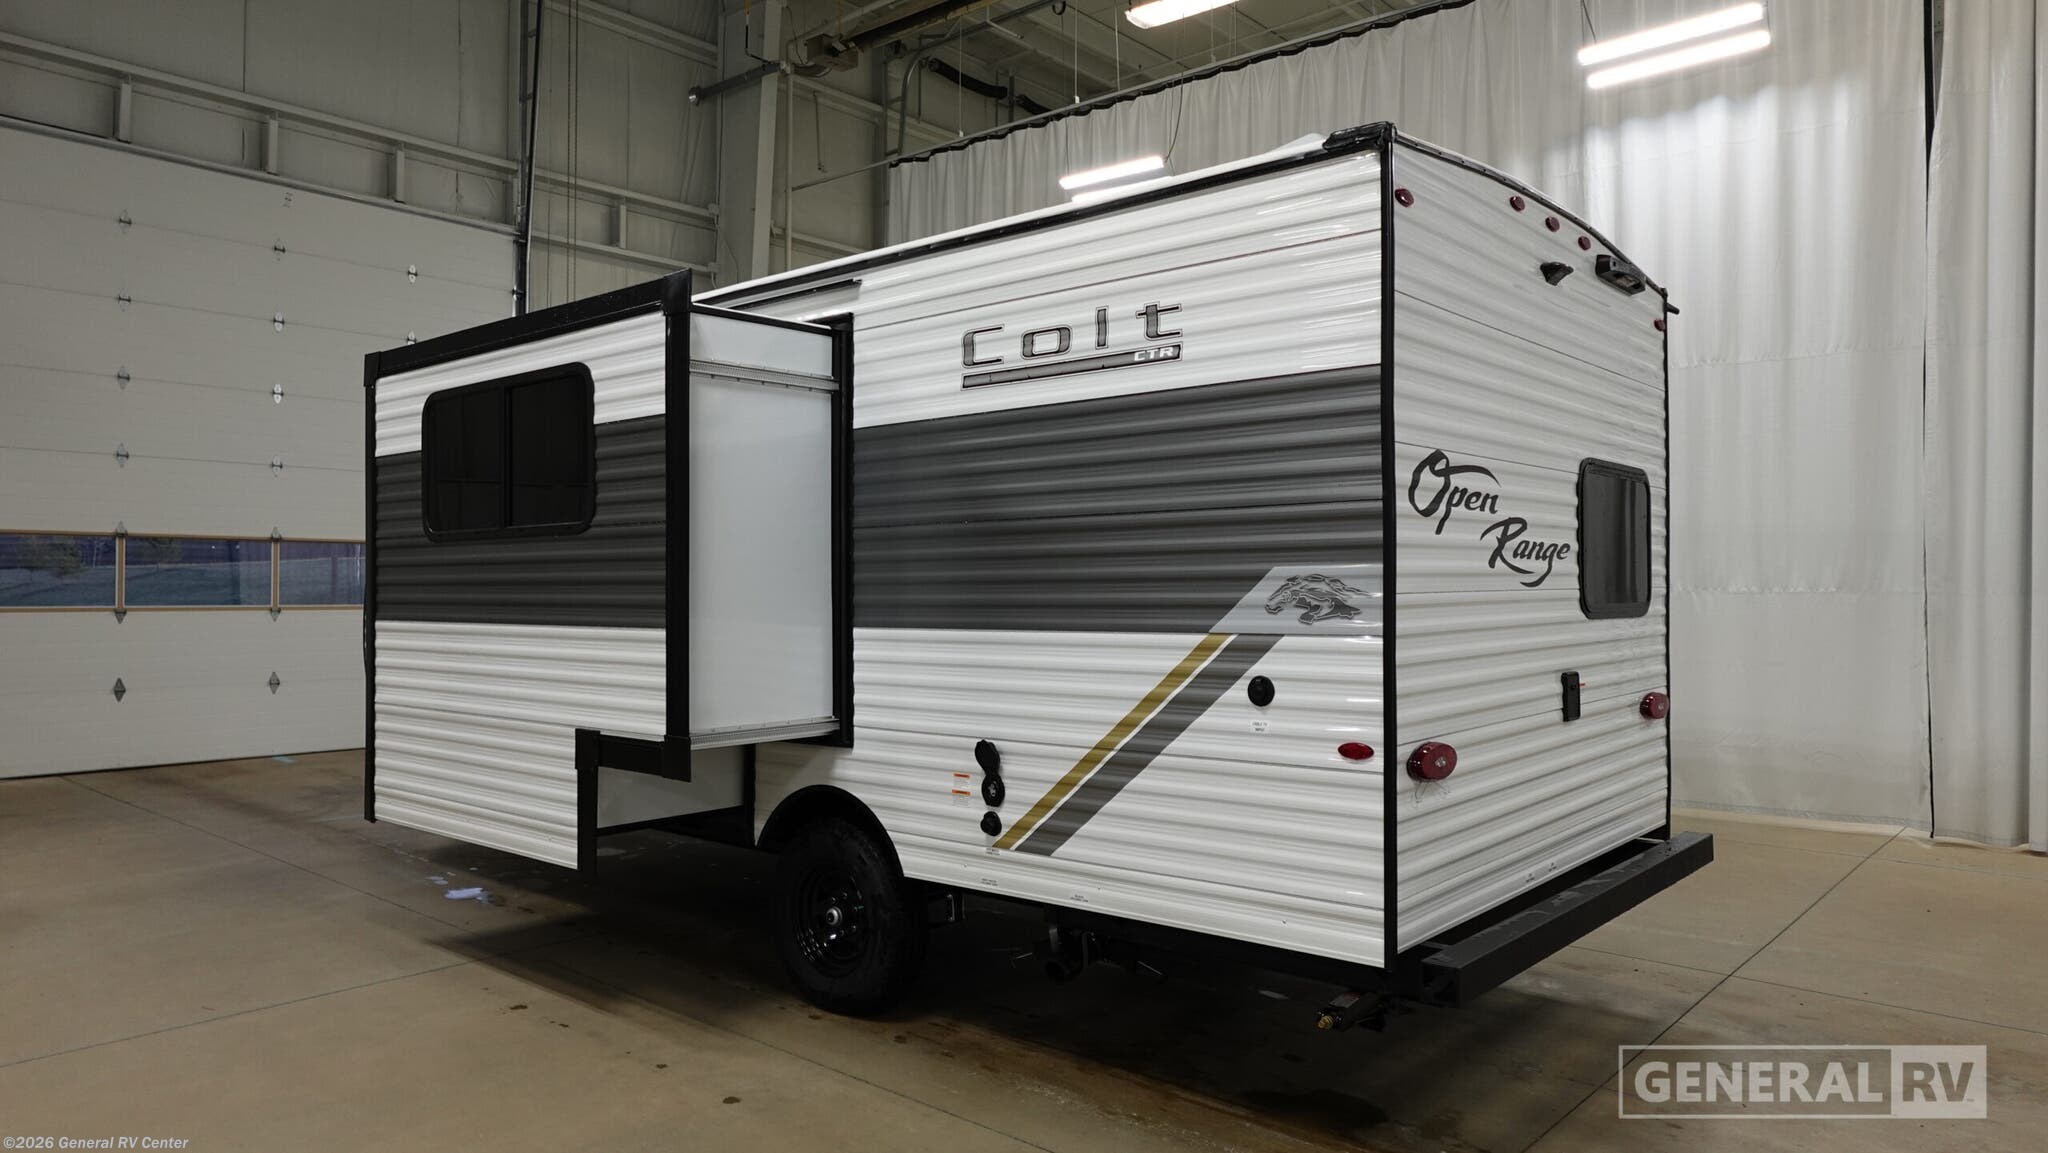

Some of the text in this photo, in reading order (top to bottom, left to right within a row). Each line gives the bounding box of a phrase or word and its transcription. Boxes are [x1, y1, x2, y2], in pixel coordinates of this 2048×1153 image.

[961, 301, 1182, 369] Colt
[1134, 347, 1174, 361] CTR
[1408, 449, 1501, 535] Open
[1480, 517, 1571, 587] Range
